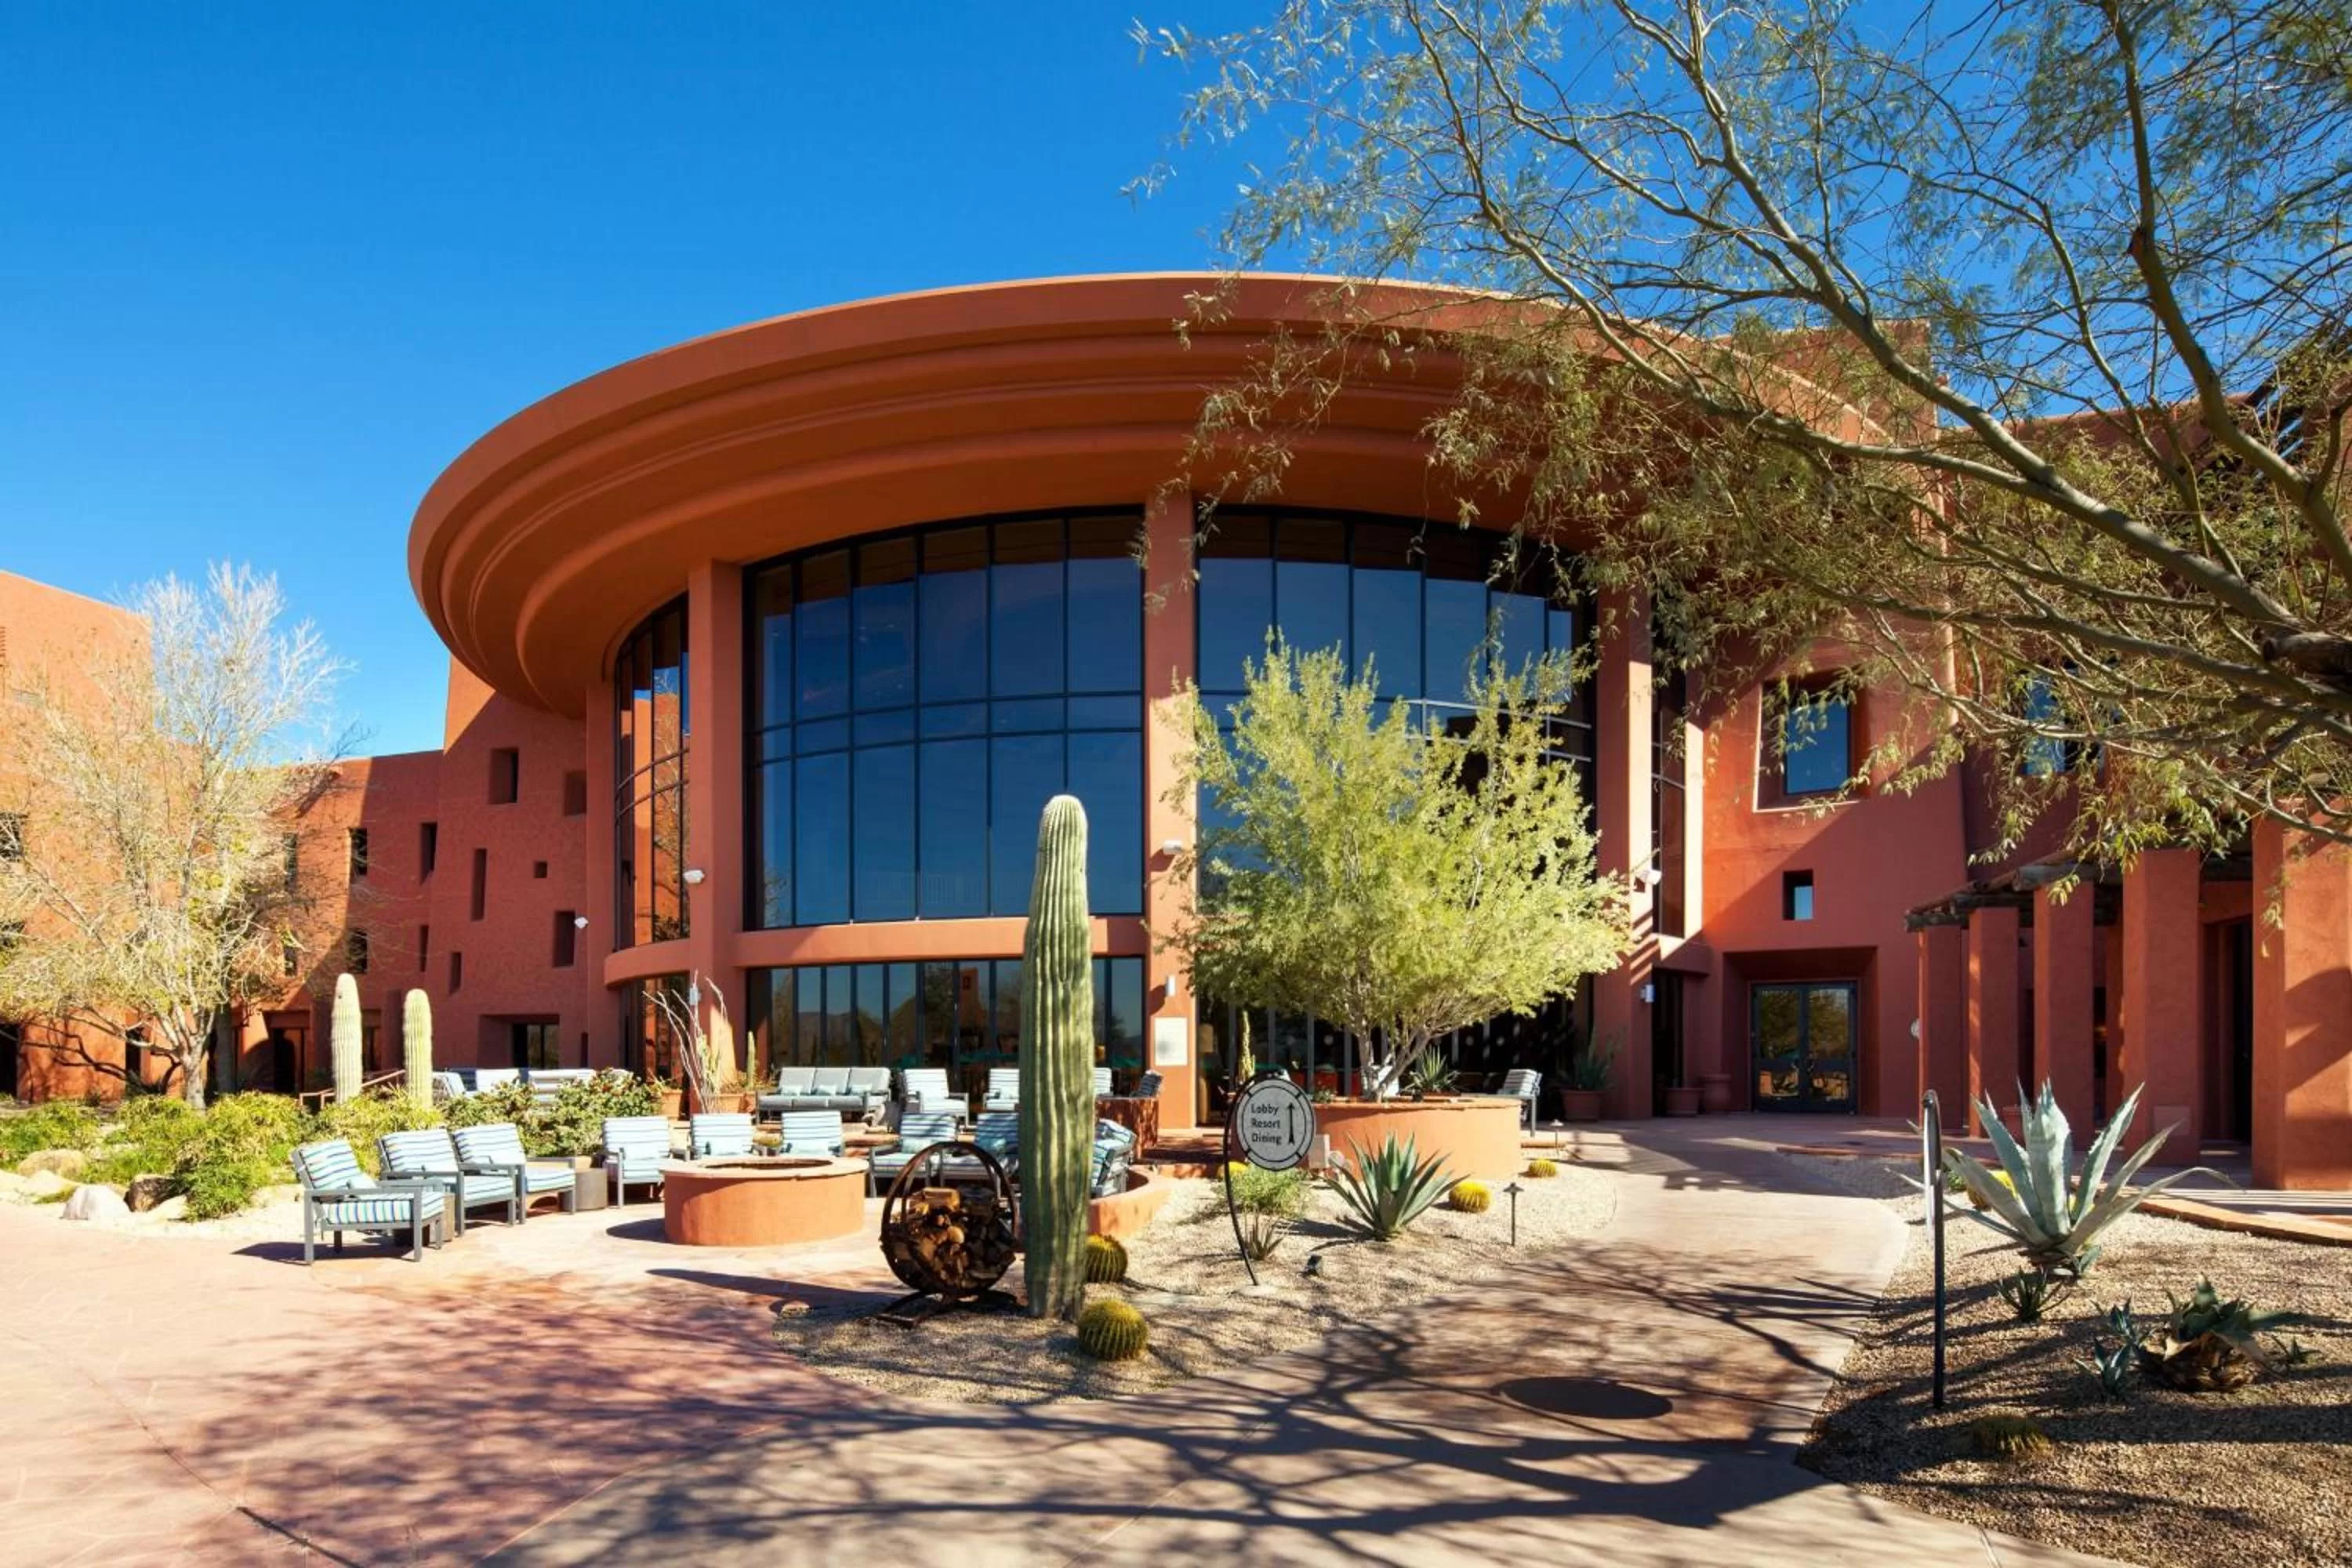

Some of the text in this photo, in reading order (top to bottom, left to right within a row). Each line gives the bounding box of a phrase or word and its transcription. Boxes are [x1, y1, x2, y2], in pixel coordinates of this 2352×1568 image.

[1250, 1103, 1279, 1116] Lobby
[1250, 1118, 1280, 1129] Resort
[1251, 1132, 1283, 1145] Dining
